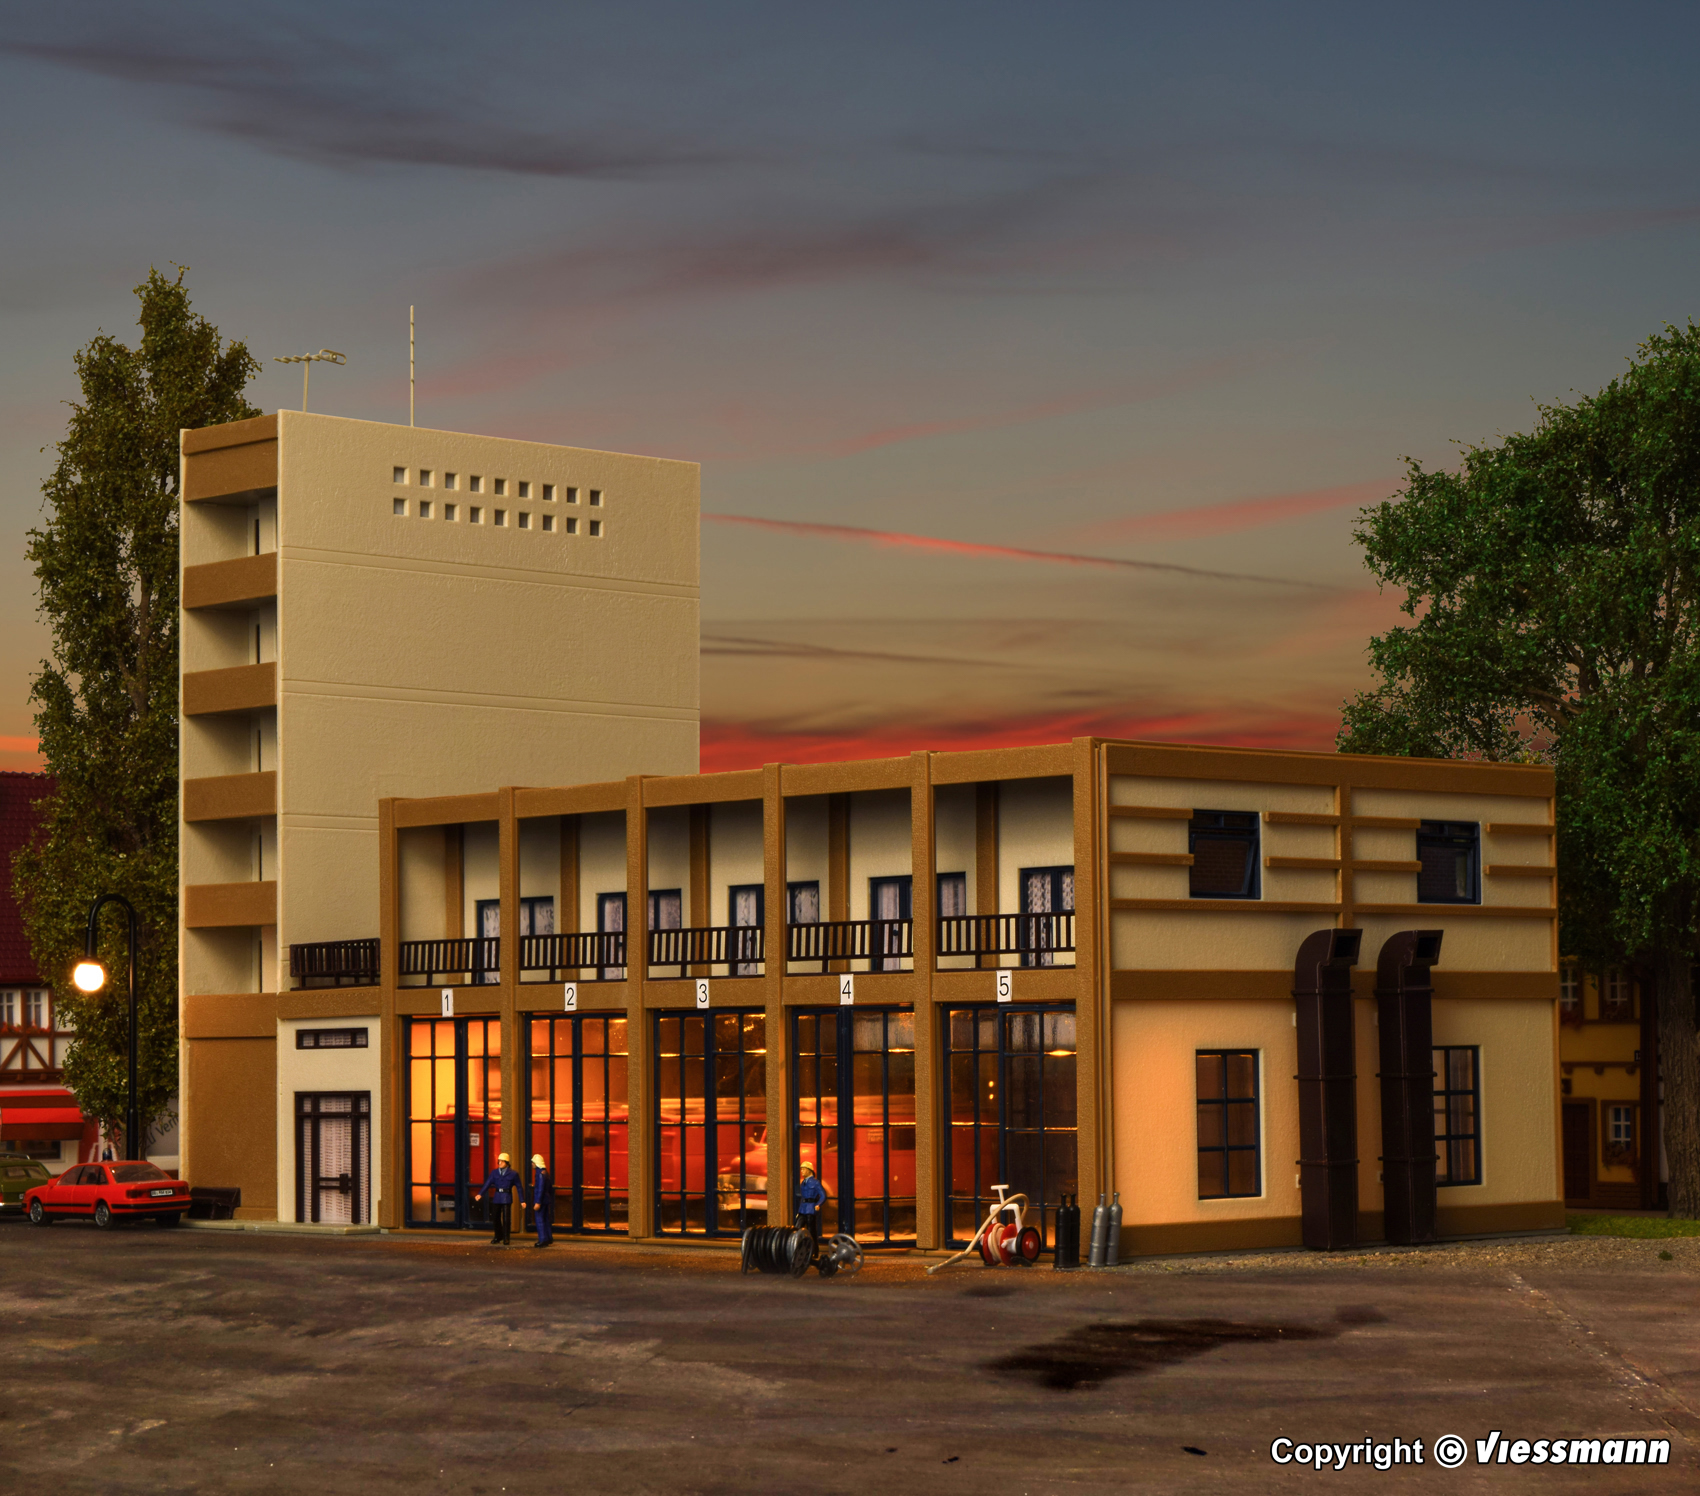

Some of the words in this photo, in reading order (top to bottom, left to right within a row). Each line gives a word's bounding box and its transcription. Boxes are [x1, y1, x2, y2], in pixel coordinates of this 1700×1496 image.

[698, 983, 708, 1003] 3
[841, 979, 852, 999] 4
[998, 975, 1010, 997] 5
[444, 994, 449, 1012] 1
[566, 987, 575, 1006] 2
